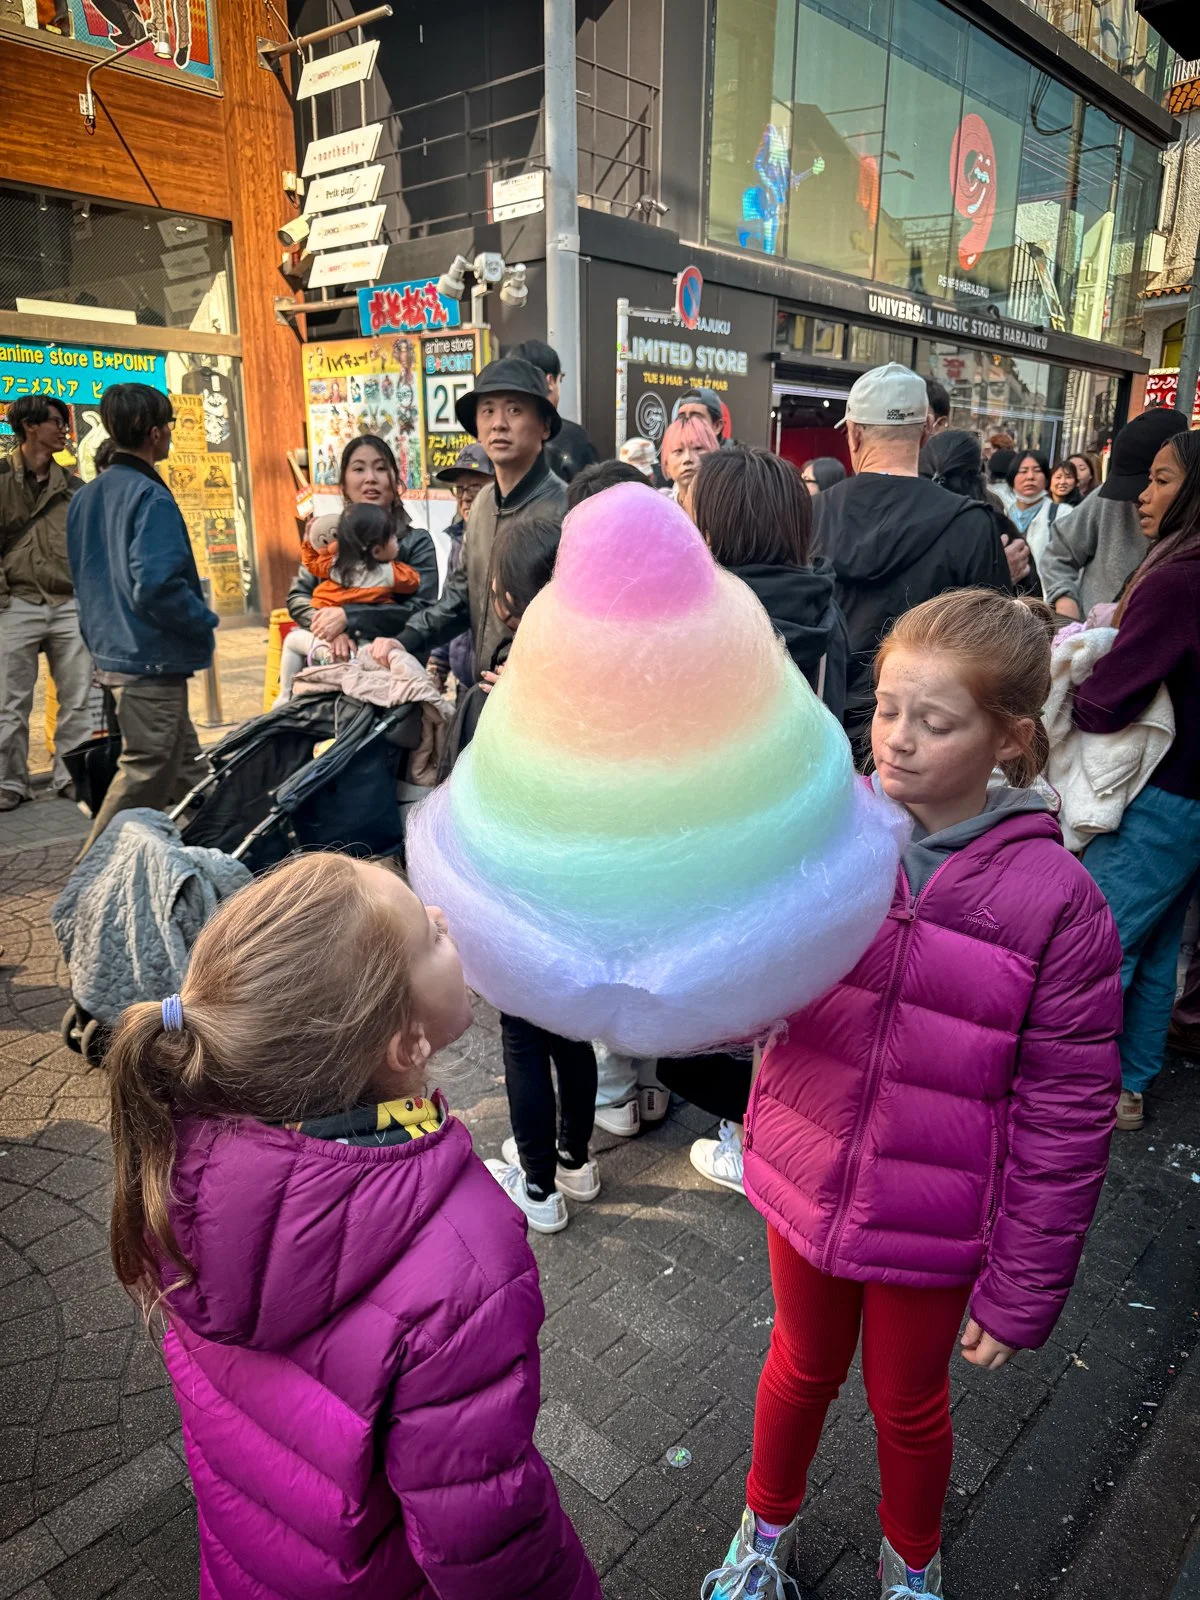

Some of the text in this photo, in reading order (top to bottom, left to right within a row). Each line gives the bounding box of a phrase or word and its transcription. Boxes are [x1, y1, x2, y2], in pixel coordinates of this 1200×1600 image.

[318, 141, 359, 161] northerly
[869, 294, 1048, 349] UNIVERSAL MUSIC STORE HARAJUKU
[0, 344, 43, 364] anime
[50, 348, 88, 368] store
[425, 338, 473, 354] anime store
[695, 344, 748, 374] STORE
[2, 376, 79, 397] アニメストア
[643, 371, 658, 384] TUE
[666, 374, 682, 387] MAR
[711, 379, 728, 391] MAR
[963, 914, 999, 930] macpac
